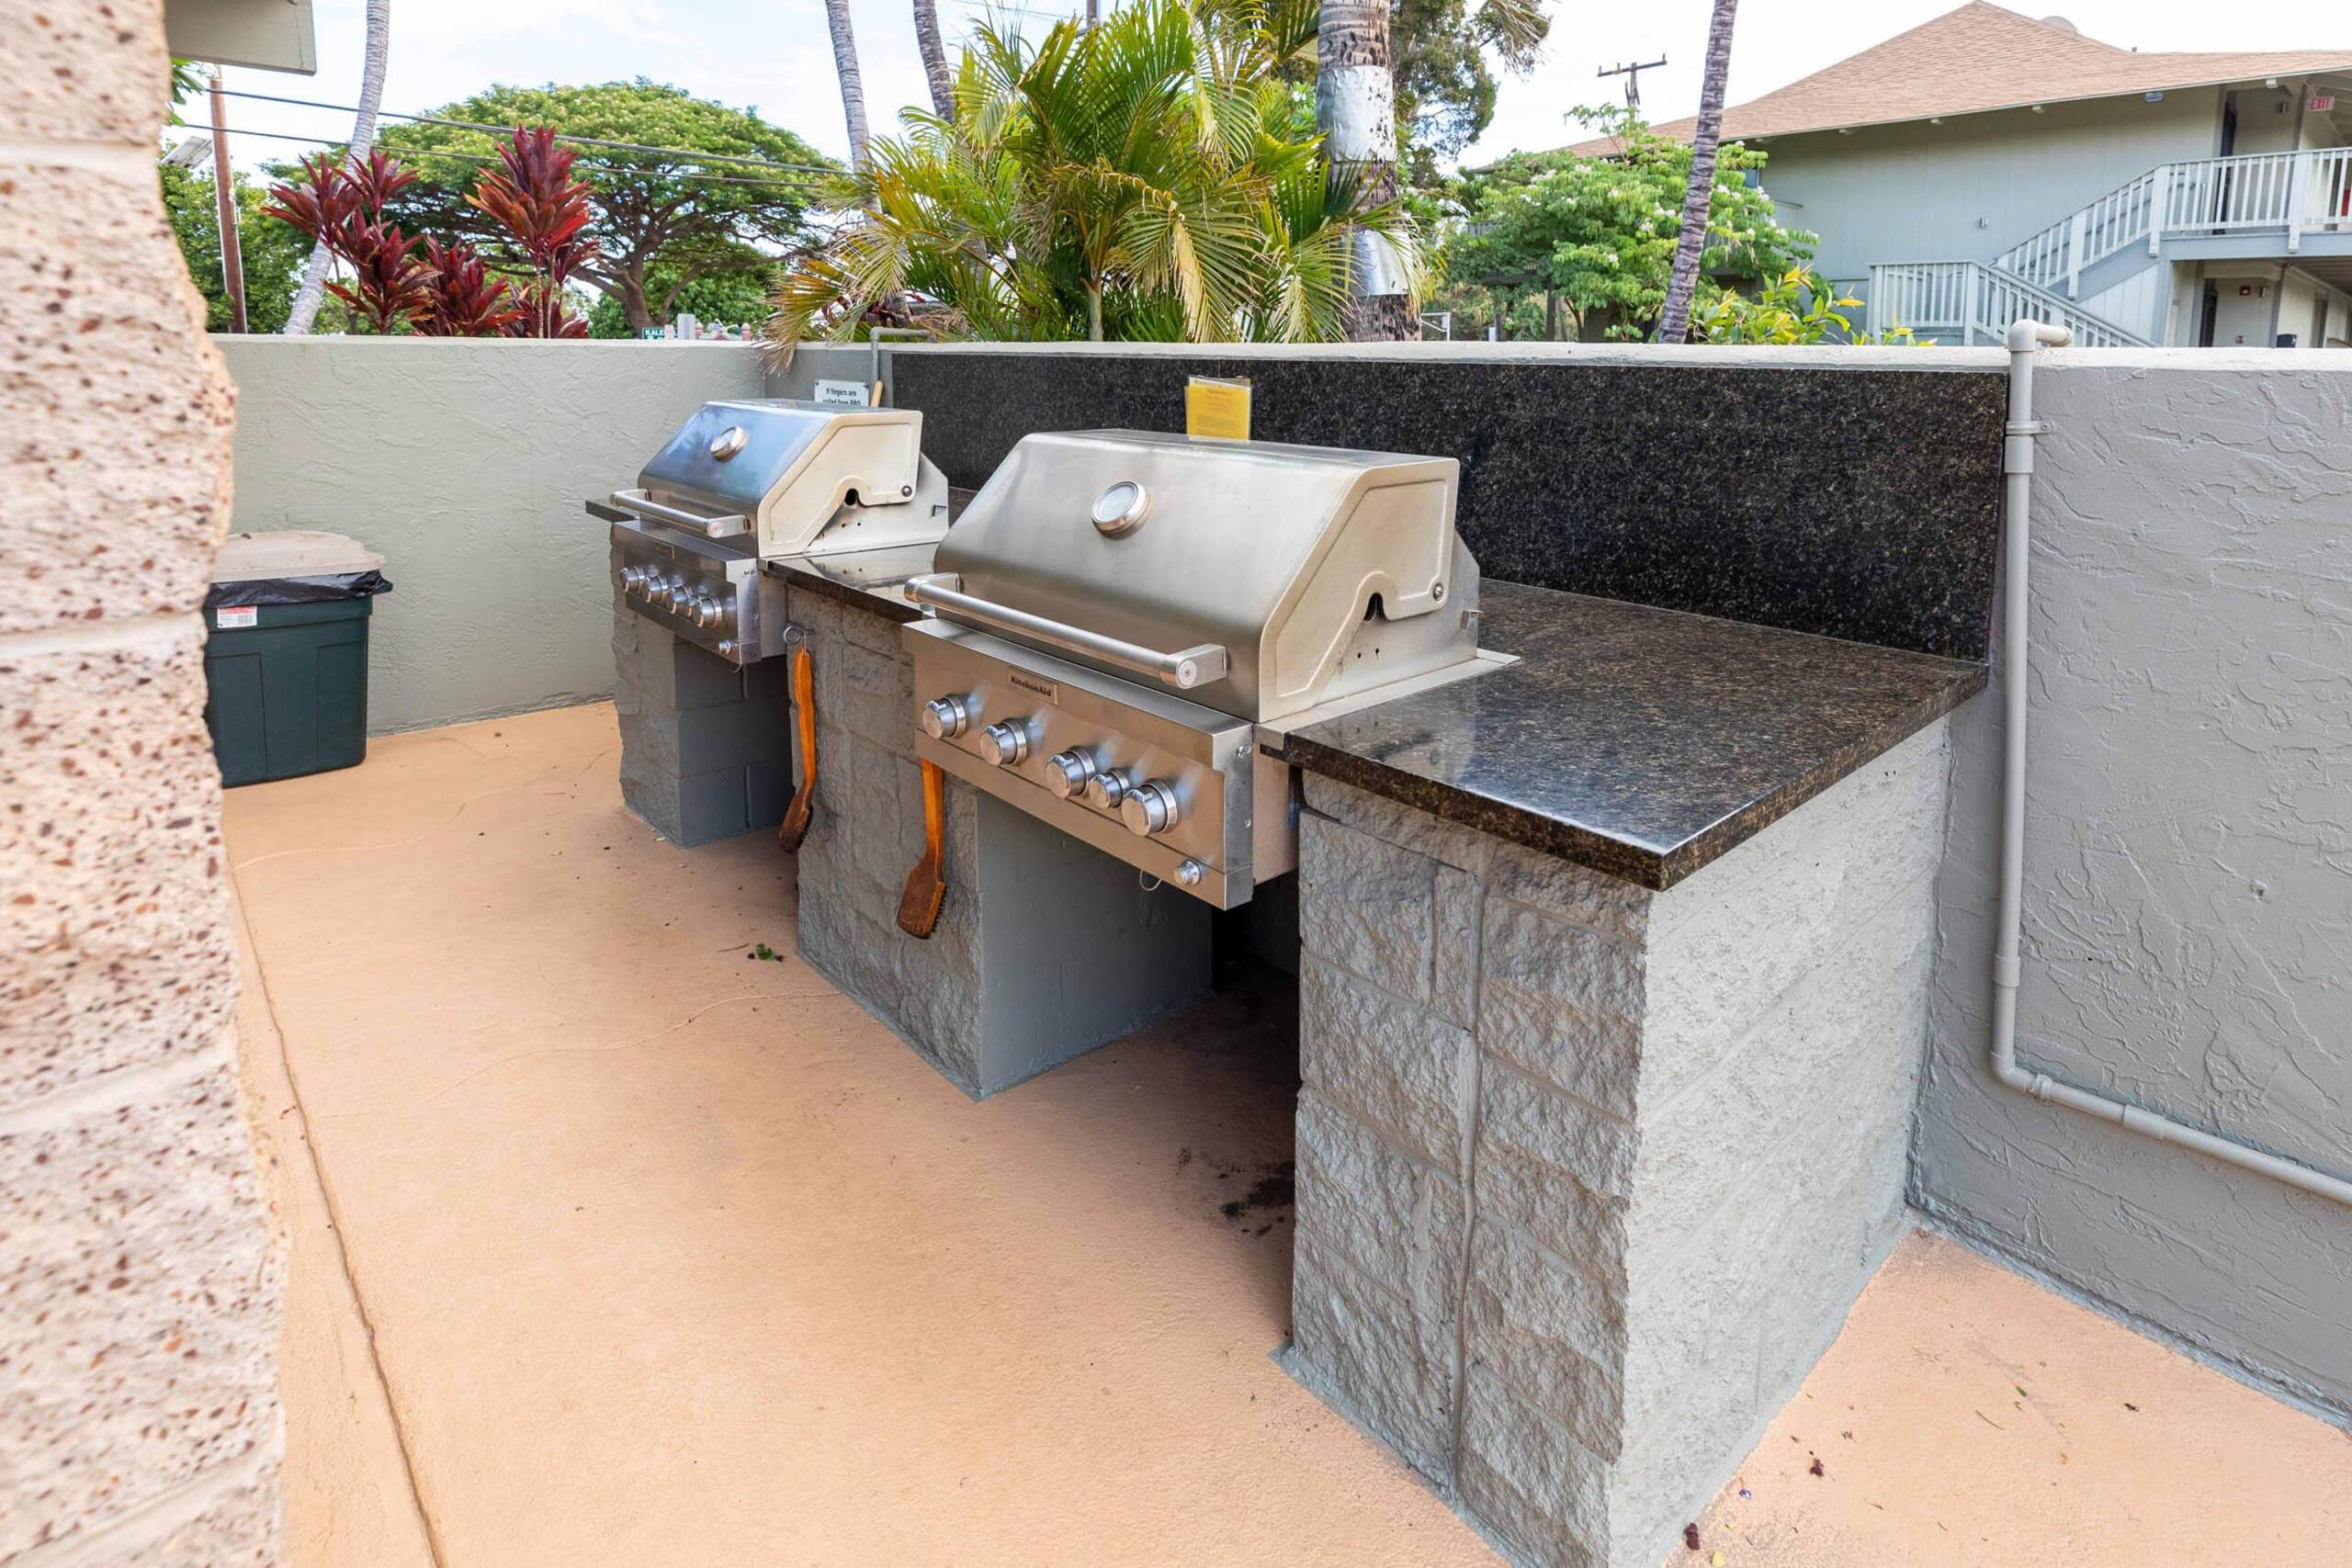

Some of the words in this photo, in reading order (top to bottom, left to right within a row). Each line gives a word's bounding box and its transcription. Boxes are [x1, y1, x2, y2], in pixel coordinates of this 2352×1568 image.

[2309, 96, 2331, 110] EXIT
[831, 388, 847, 397] fingers
[1011, 675, 1051, 697] KitchenAid
